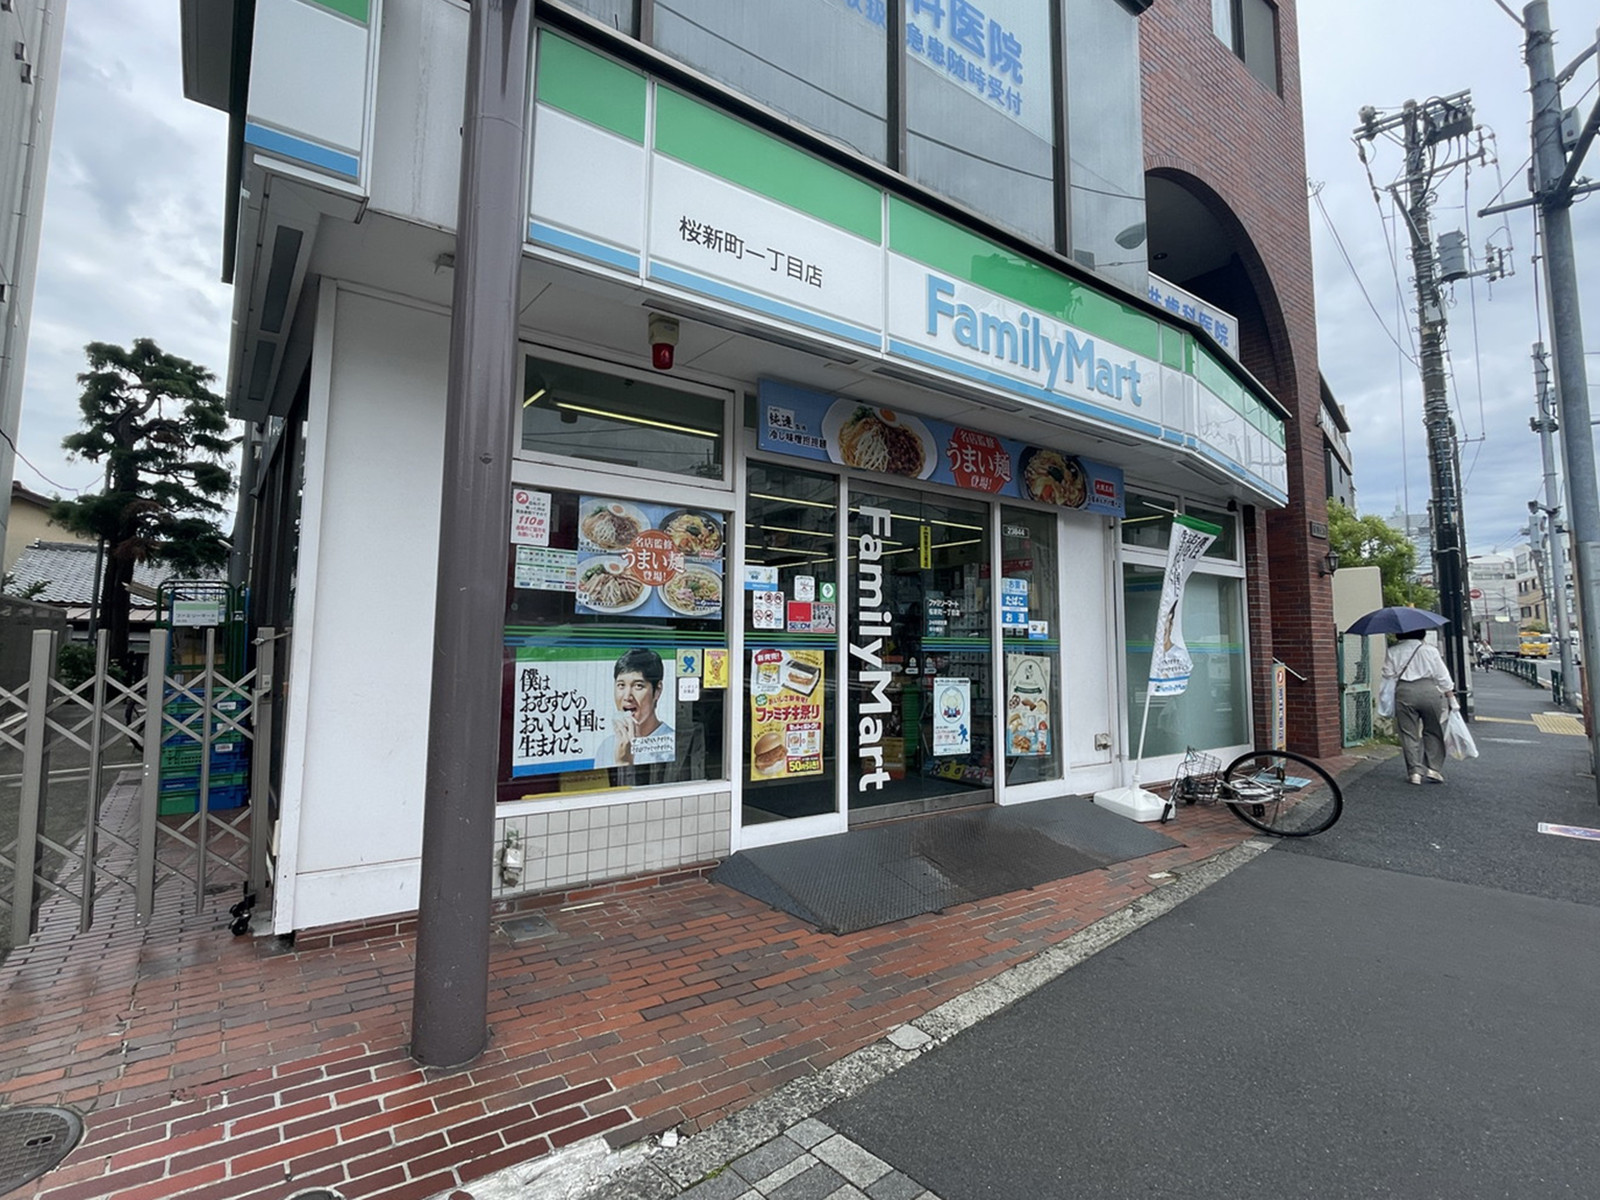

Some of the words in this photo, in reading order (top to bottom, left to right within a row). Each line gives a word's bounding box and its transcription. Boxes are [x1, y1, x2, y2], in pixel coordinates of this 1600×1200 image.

[906, 22, 1023, 116] 急患随時受付
[679, 216, 823, 288] 桜新町一丁目店
[926, 273, 1143, 407] FamilyMart
[946, 440, 1011, 482] うまい麺
[635, 537, 673, 549] 名店監修
[621, 547, 686, 573] うまい麺
[643, 571, 667, 582] 登場!
[1005, 595, 1025, 606] たばこ
[850, 505, 892, 792] FamilyMart
[520, 668, 551, 692] 僕は
[520, 689, 588, 713] おむすびの
[756, 704, 820, 722] ファミチキ祭り
[519, 709, 606, 735] おいしい国に
[518, 733, 583, 758] 生まれた。
